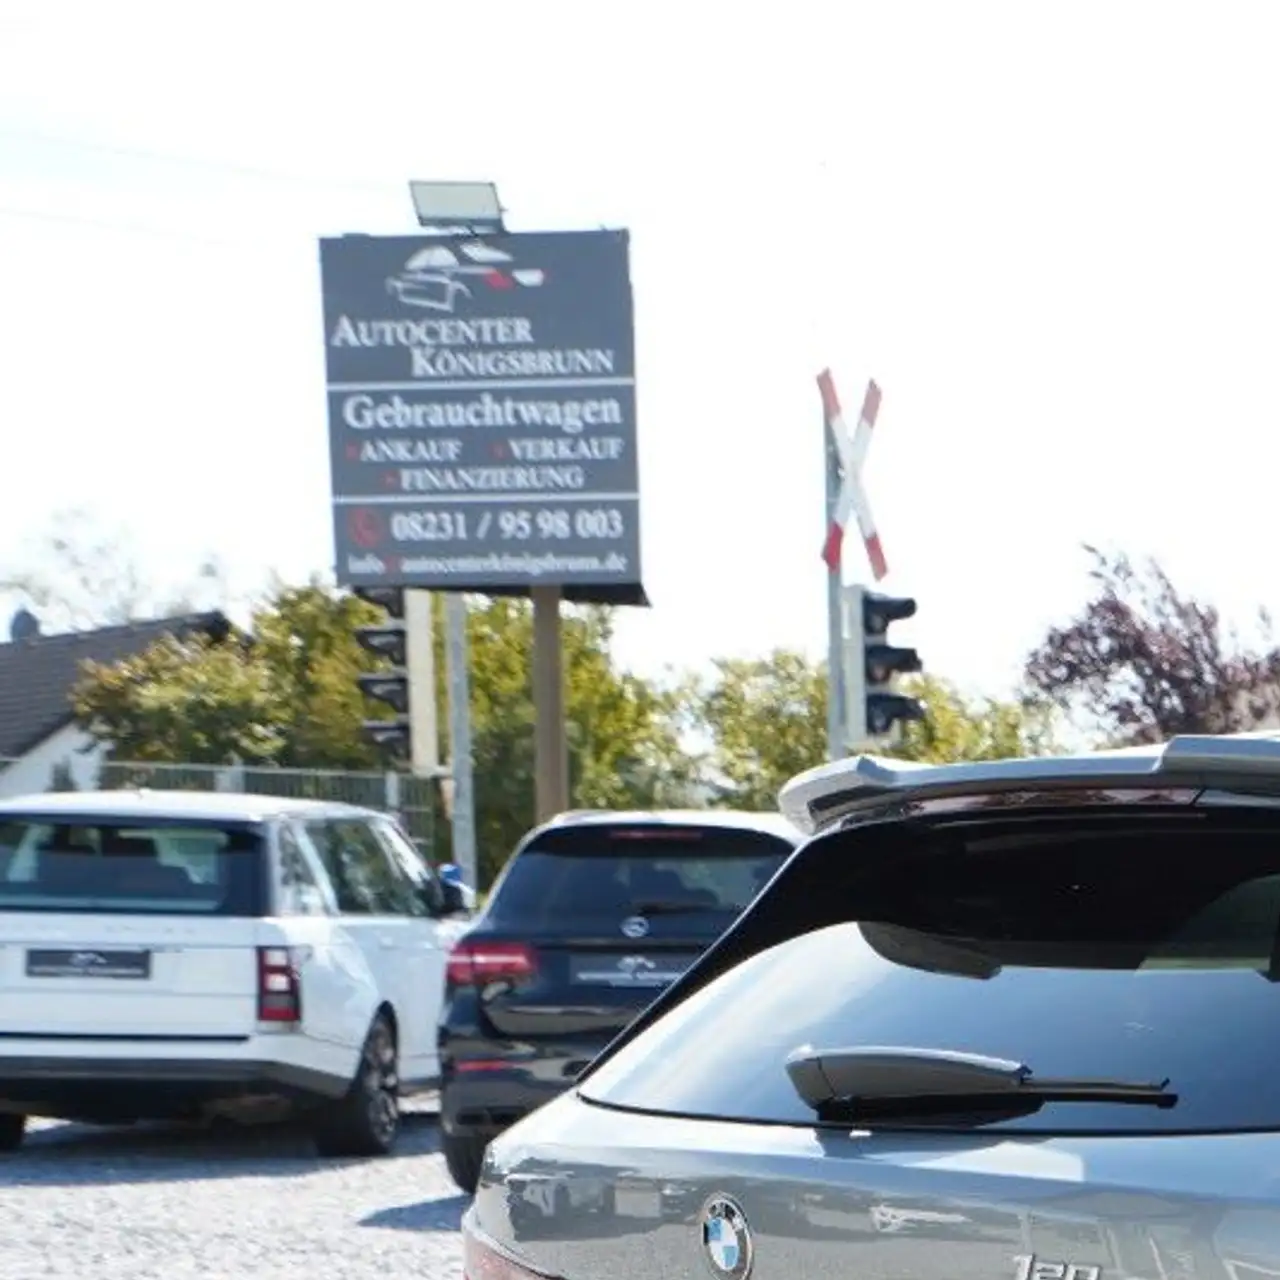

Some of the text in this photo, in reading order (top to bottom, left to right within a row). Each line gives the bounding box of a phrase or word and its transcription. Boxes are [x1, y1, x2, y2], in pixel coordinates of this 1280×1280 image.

[331, 315, 534, 348] AUTOCENTER
[410, 348, 615, 378] KÖNIGSBRUNN
[343, 393, 621, 433] Gebrauchtwagen
[359, 438, 625, 462] ANKAUF VERKAUF
[400, 465, 585, 490] FINANZIERUNG
[391, 512, 468, 541] 08231
[499, 510, 531, 540] 95
[537, 509, 570, 539] 98
[575, 508, 623, 539] 003
